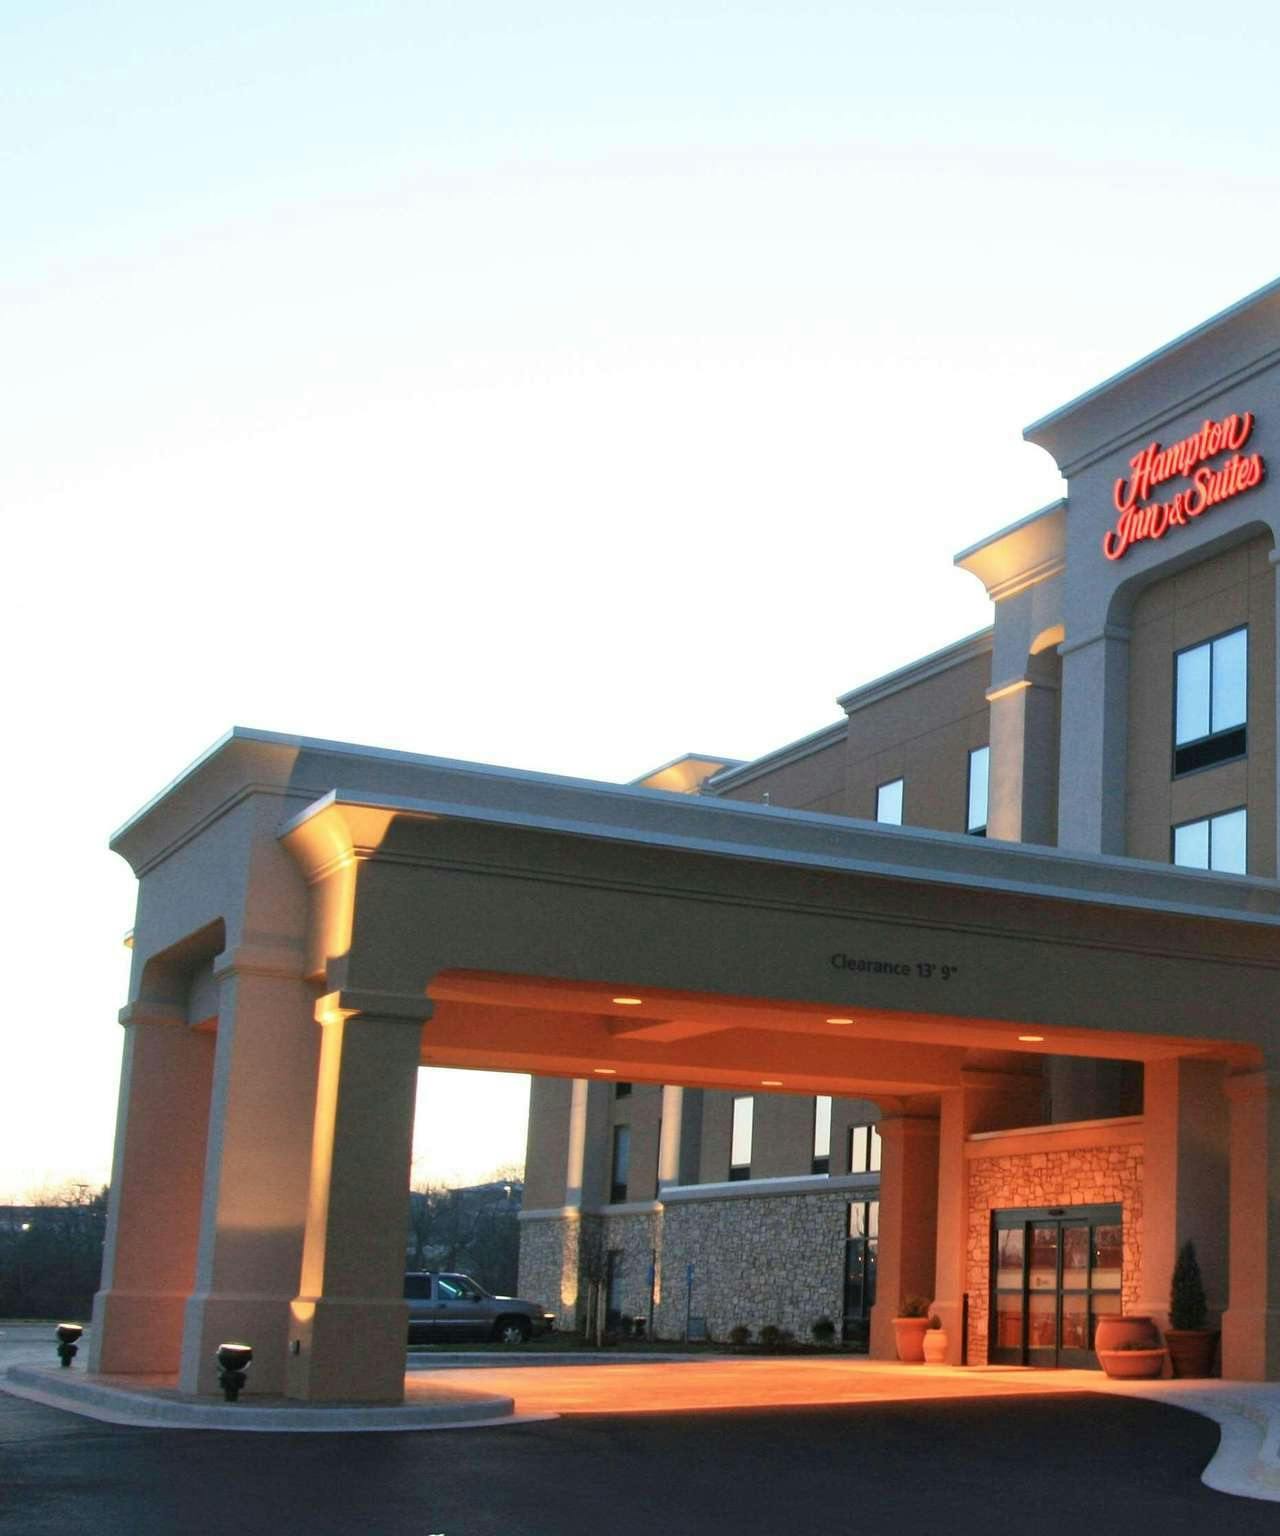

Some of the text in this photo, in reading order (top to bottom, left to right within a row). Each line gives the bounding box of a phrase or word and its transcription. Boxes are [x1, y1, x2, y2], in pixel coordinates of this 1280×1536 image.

[1103, 453, 1264, 561] Inn & Suites
[1113, 411, 1255, 513] Hampton
[831, 953, 912, 976] Clearance
[916, 962, 937, 978] 13'
